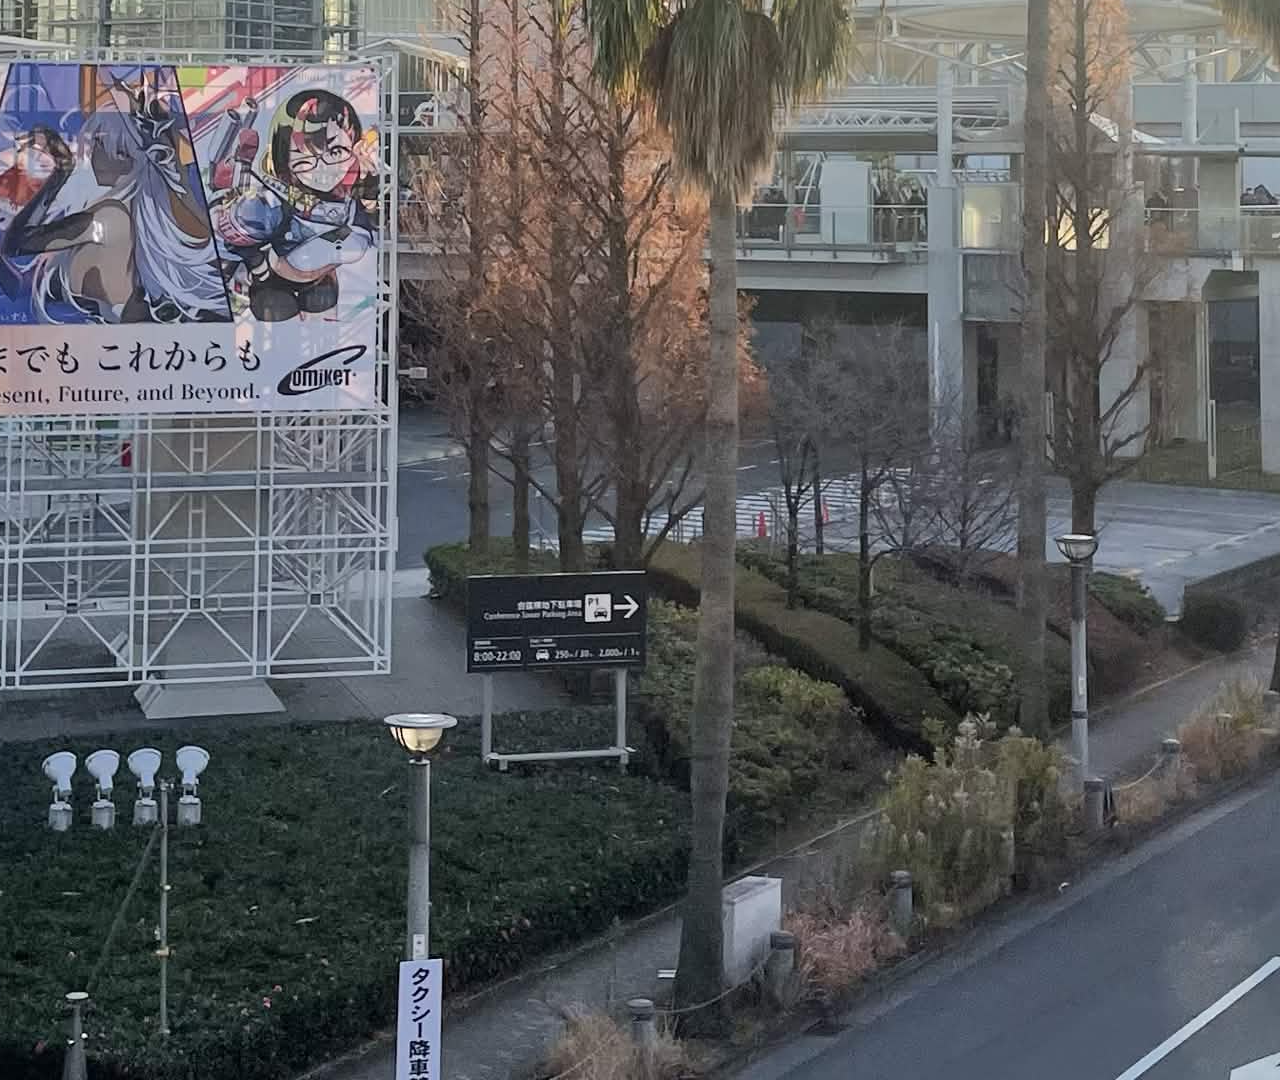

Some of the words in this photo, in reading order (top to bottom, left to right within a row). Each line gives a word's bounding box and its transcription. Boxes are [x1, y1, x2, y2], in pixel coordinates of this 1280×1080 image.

[98, 340, 261, 372] これからも
[58, 385, 130, 403] Future,
[136, 383, 174, 402] and
[181, 383, 262, 404] Beyond.
[587, 597, 600, 606] P1
[408, 967, 431, 1080] タクシー降車
